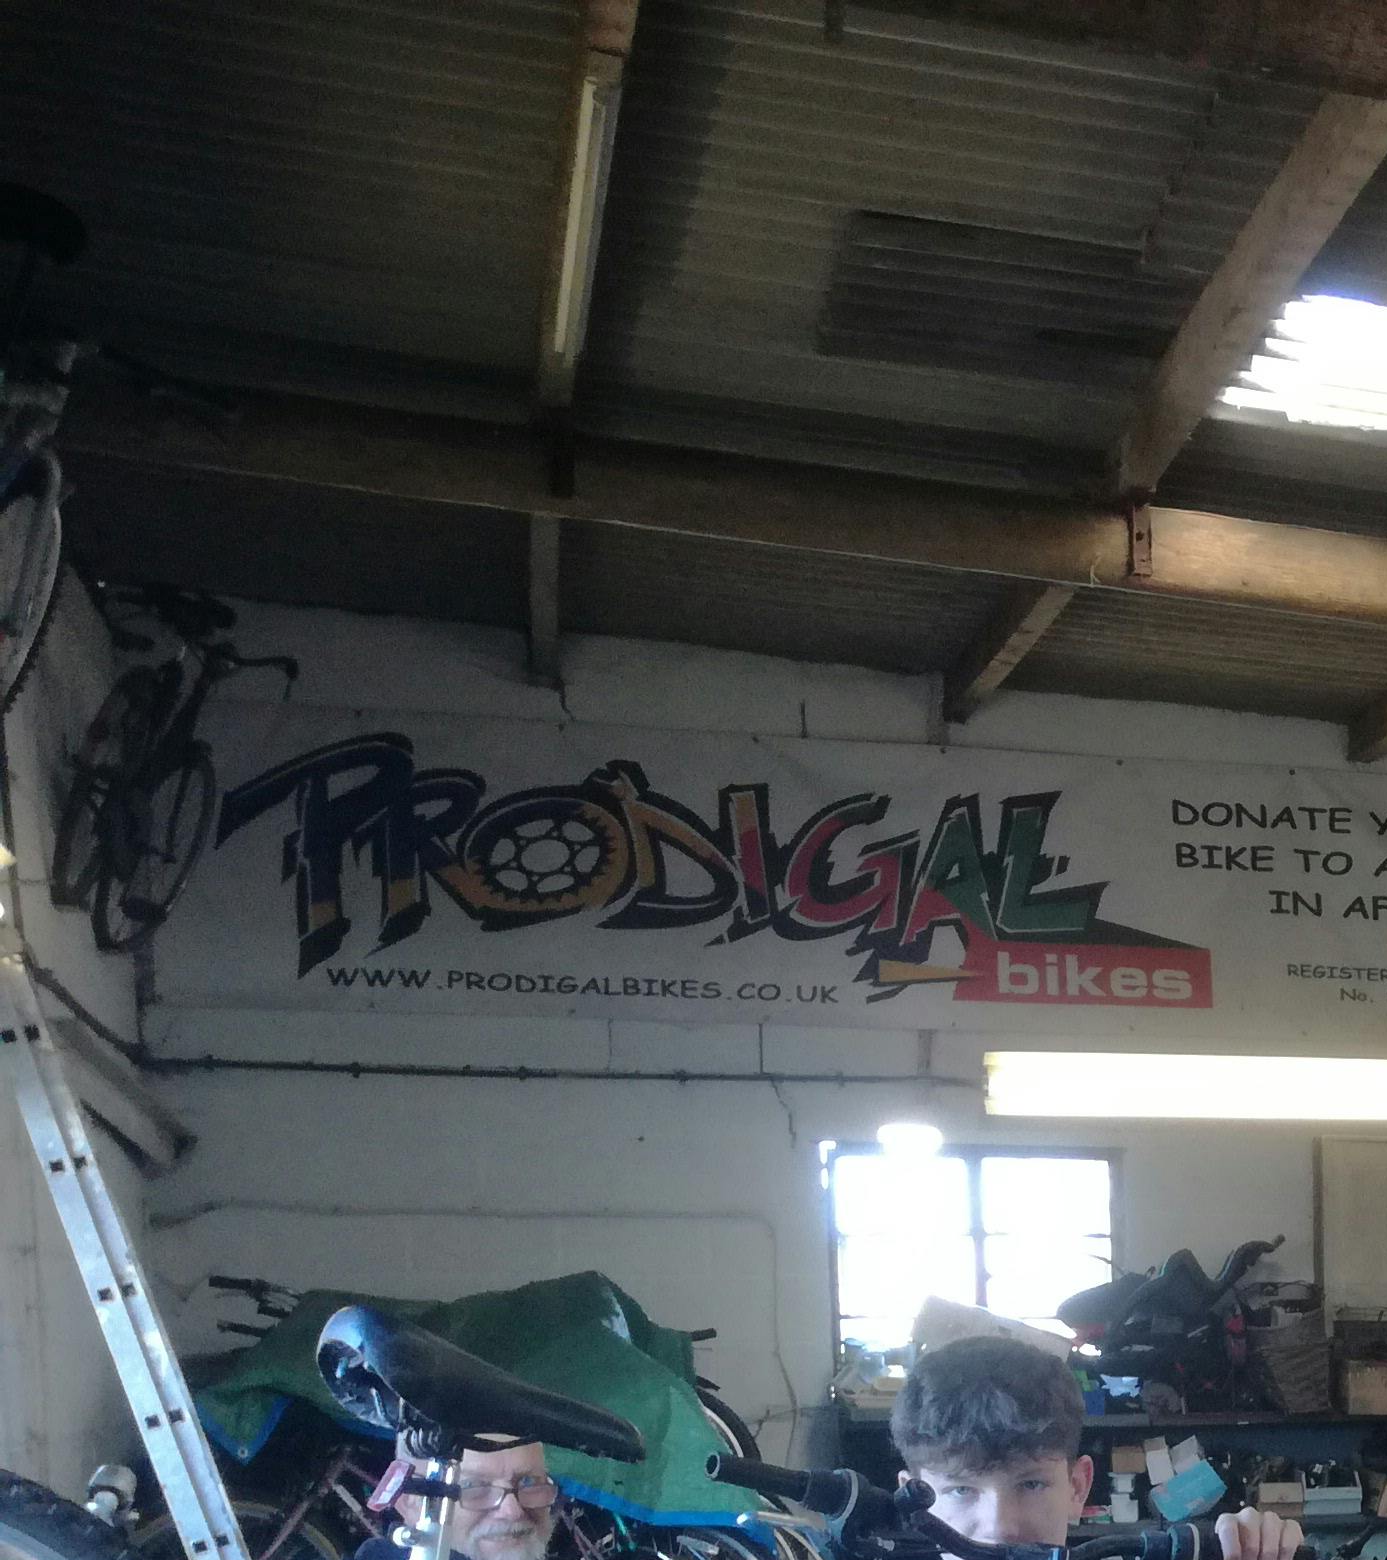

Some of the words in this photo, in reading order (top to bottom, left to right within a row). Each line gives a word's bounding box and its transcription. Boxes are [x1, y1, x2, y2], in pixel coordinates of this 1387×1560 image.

[1171, 799, 1353, 835] DONATE
[1174, 842, 1275, 873] BIKE
[1293, 847, 1355, 877] TO
[1269, 890, 1324, 918] IN
[327, 965, 839, 1006] WWW.PRODIGALBIKES.CO.UK
[996, 950, 1193, 1001] bikes
[1339, 988, 1374, 1005] No.
